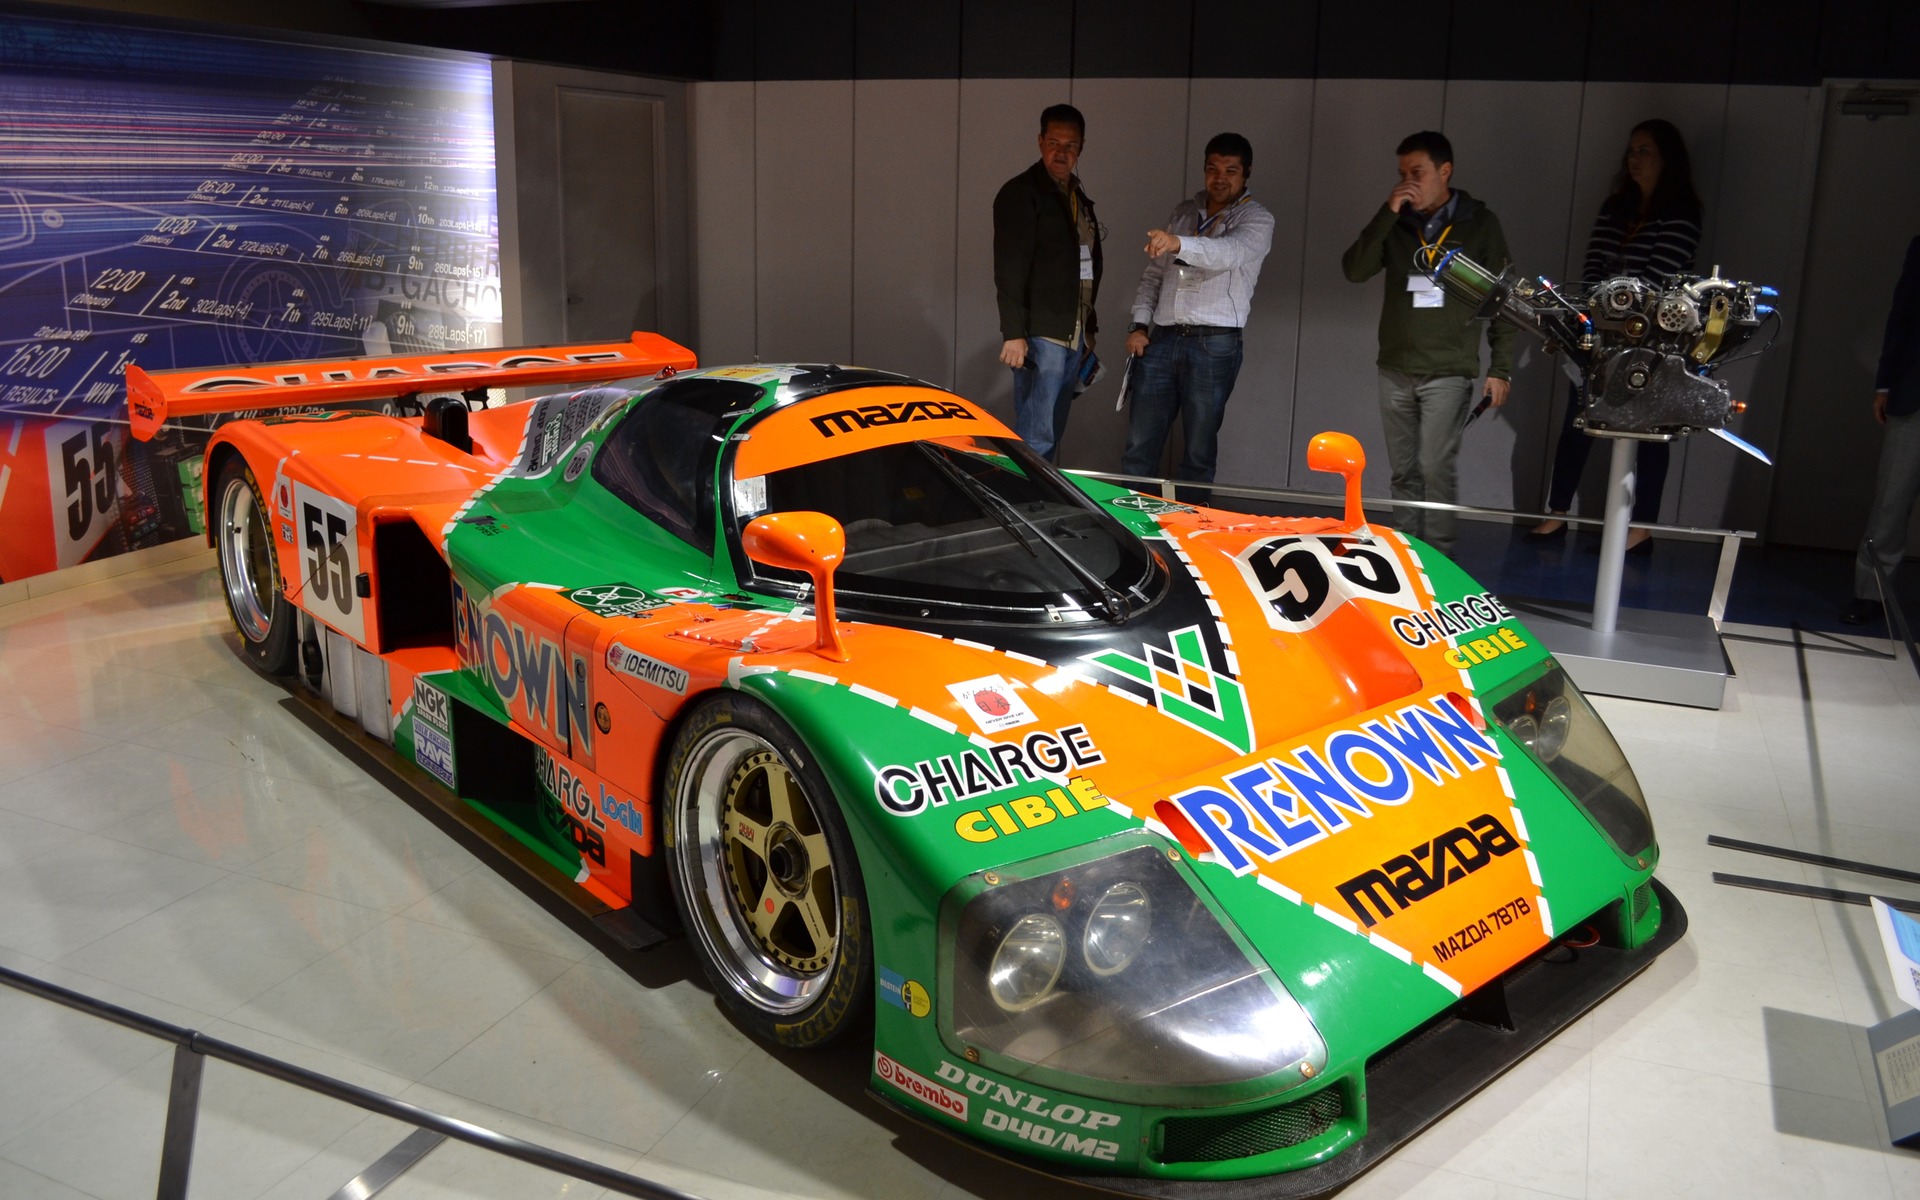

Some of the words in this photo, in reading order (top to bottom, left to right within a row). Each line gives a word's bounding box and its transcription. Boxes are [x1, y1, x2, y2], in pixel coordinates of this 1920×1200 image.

[231, 152, 264, 164] 04:00
[277, 163, 292, 173] 3rd
[197, 180, 236, 195] 06:00
[249, 193, 269, 205] 2nd
[153, 216, 197, 234] 10:00
[334, 203, 349, 215] 6th
[417, 212, 435, 225] 10th
[212, 233, 237, 249] 2nd
[238, 240, 290, 256] 272Laps[-3]
[312, 244, 328, 260] 7th
[337, 251, 385, 268] 266Laps[-9]
[90, 267, 146, 293] 12:00
[408, 255, 424, 271] 9th
[159, 290, 190, 311] 2nd
[191, 298, 254, 321] 302Laps[-4]
[402, 266, 502, 309] GACHO
[280, 302, 301, 324] 7th
[310, 311, 374, 333] 295Laps[-11]
[396, 314, 415, 337] 9th
[428, 325, 487, 347] 289Laps[-17]
[0, 343, 72, 379] 16:00
[4, 385, 59, 405] RESULTS
[83, 382, 120, 405] WIN
[809, 401, 978, 438] mazda
[61, 415, 116, 541] 55
[303, 502, 353, 615] 55
[1248, 537, 1401, 622] 55
[1392, 593, 1515, 647] CHARGE
[452, 573, 592, 757] ENOWN
[623, 653, 688, 692] IDEMITSU
[416, 683, 446, 720] NGK
[415, 735, 452, 774] RAYS
[875, 725, 1105, 815] CHARGE
[1172, 695, 1501, 875] RENOWN
[954, 776, 1111, 843] CIBIÉ
[1335, 813, 1521, 928] mazda
[1432, 918, 1493, 963] MAZDA
[1487, 897, 1531, 932] 787B
[879, 977, 901, 996] BILSTEIN
[894, 1066, 965, 1114] brembo
[934, 1060, 1121, 1130] DUNLOP
[982, 1108, 1120, 1161] D40/M2
